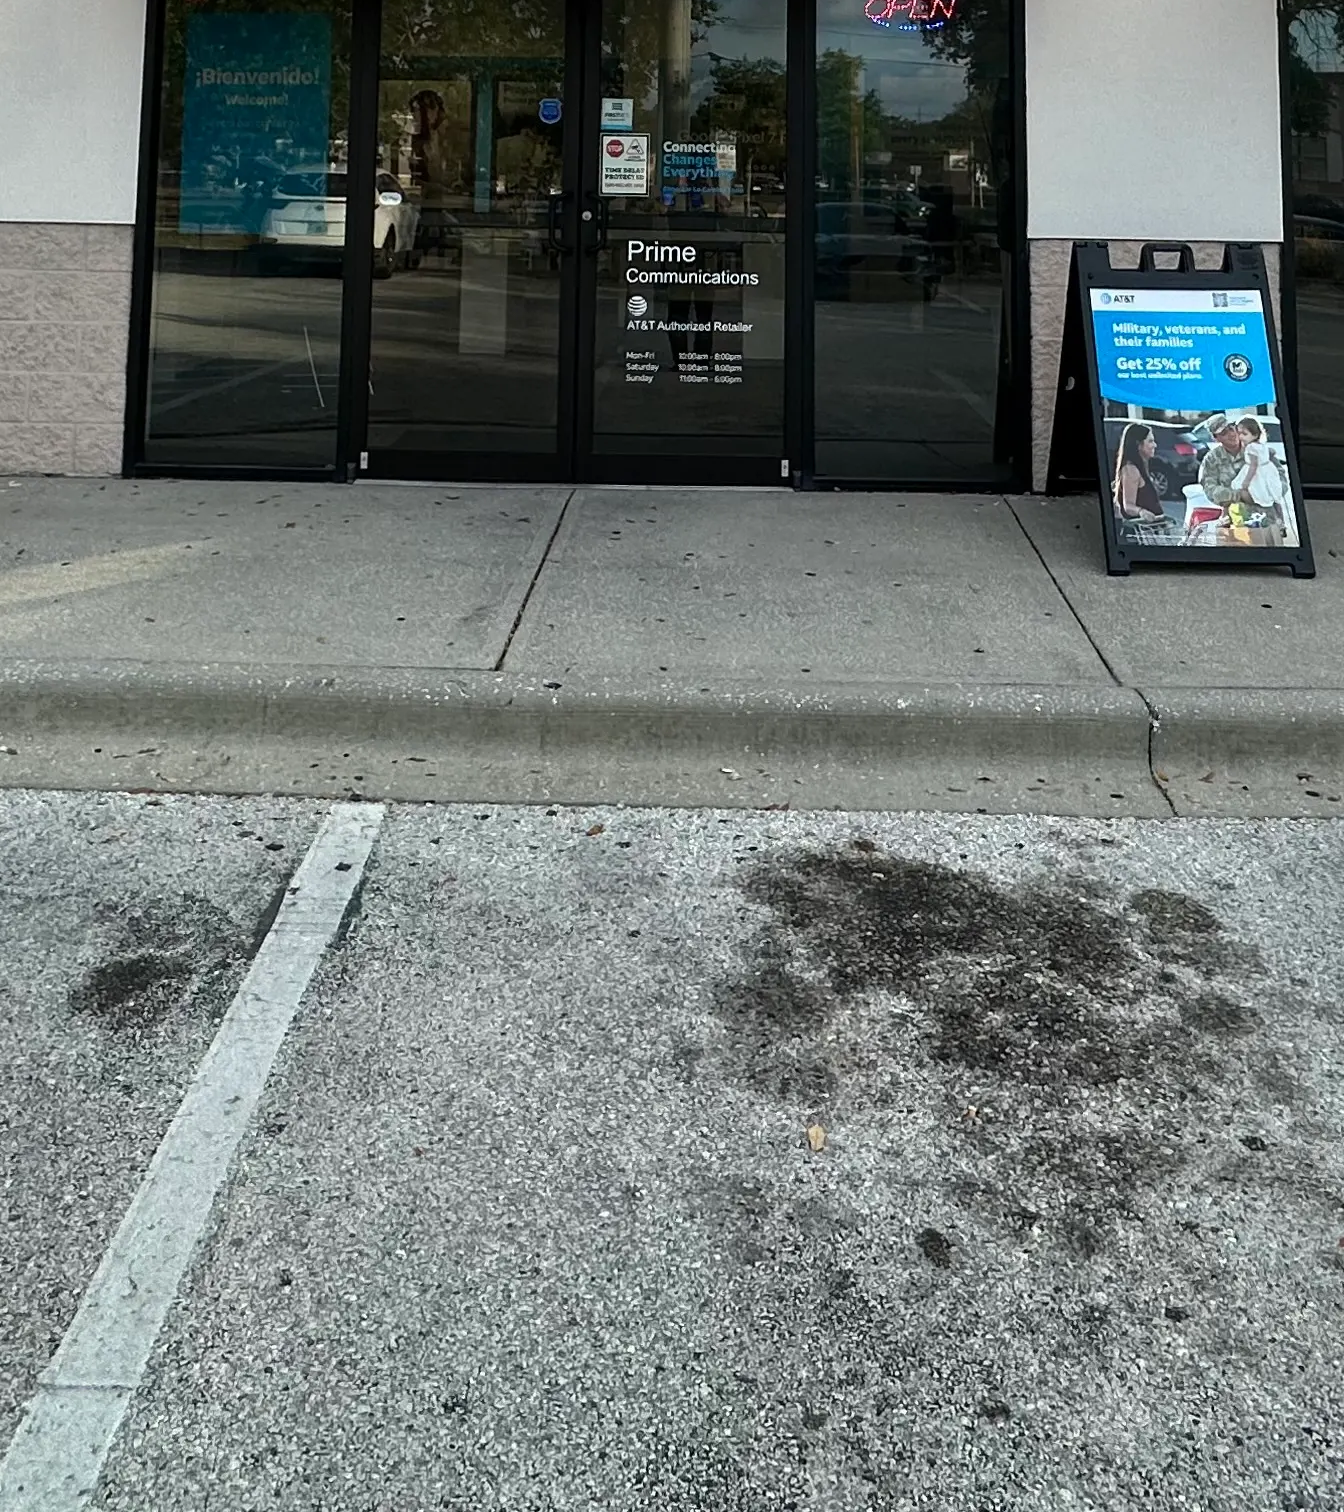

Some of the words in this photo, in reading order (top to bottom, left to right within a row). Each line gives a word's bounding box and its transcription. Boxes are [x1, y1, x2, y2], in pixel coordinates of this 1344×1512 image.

[195, 66, 320, 87] ¡Bienvenido!
[224, 92, 289, 107] Welcome!
[663, 140, 736, 153] Connecting
[663, 153, 717, 167] Changes
[627, 240, 697, 263] Prime
[625, 267, 760, 286] Communications
[1113, 294, 1136, 304] AT&T
[626, 320, 656, 331] AT&T
[656, 320, 712, 332] Authorized
[713, 321, 754, 333] Retailer
[1113, 322, 1163, 337] Military,
[1165, 323, 1221, 337] veterans,
[1223, 323, 1247, 335] and
[1114, 336, 1143, 348] their
[1144, 336, 1194, 348] families
[625, 351, 655, 360] Mon-Fri
[625, 363, 660, 373] Saturday
[1116, 357, 1144, 371] Get
[1145, 357, 1177, 371] 25%
[1178, 357, 1203, 371] off
[625, 374, 654, 384] Sunday
[1130, 371, 1147, 379] best
[1147, 371, 1182, 380] unlimited
